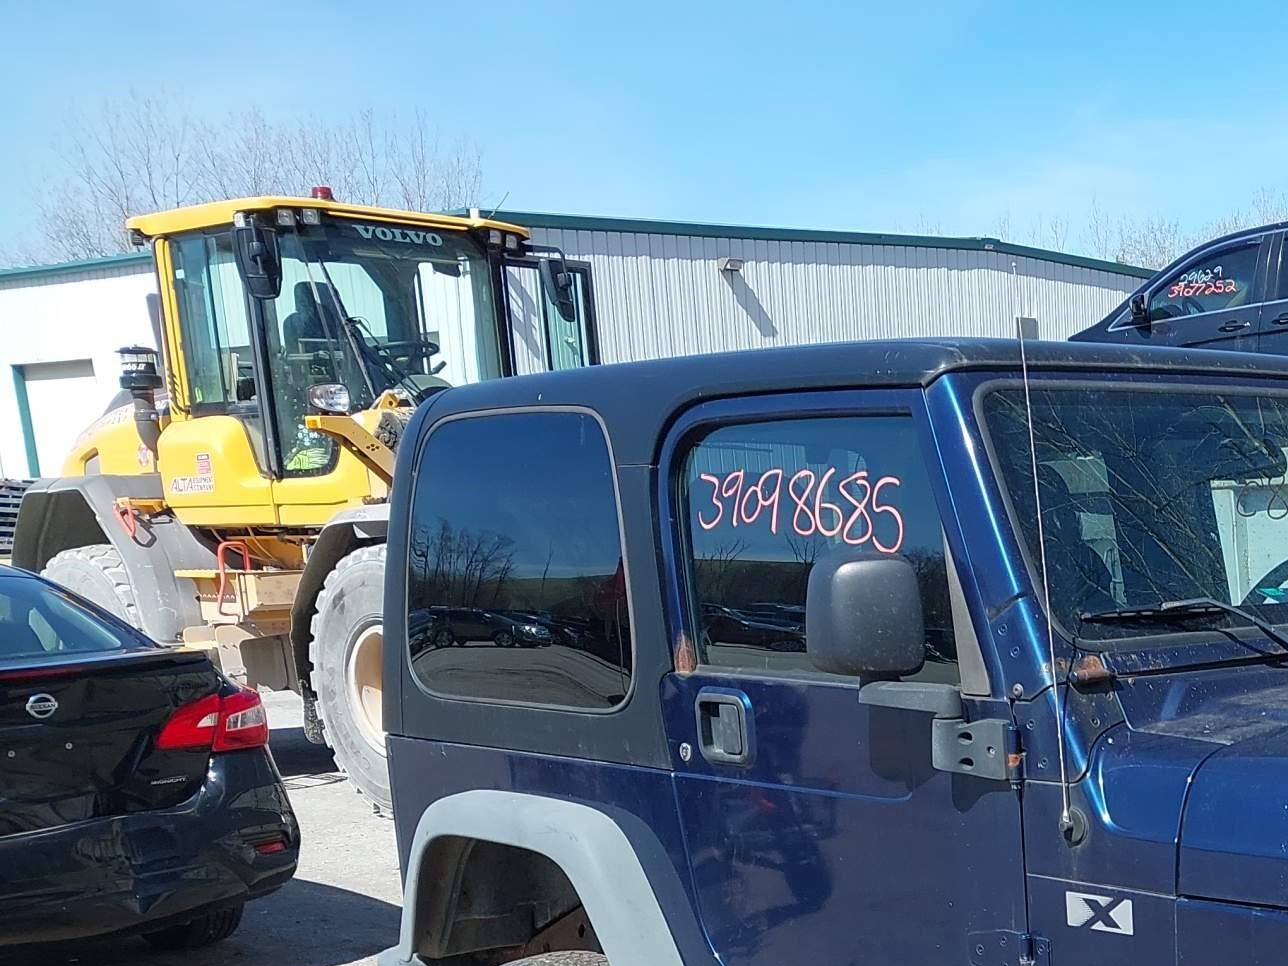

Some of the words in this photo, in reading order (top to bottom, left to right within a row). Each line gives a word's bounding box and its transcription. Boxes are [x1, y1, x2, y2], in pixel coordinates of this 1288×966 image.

[352, 224, 443, 247] VOLVO
[171, 477, 193, 492] ALTA
[699, 467, 904, 553] 39098685
[1076, 895, 1126, 931] X
